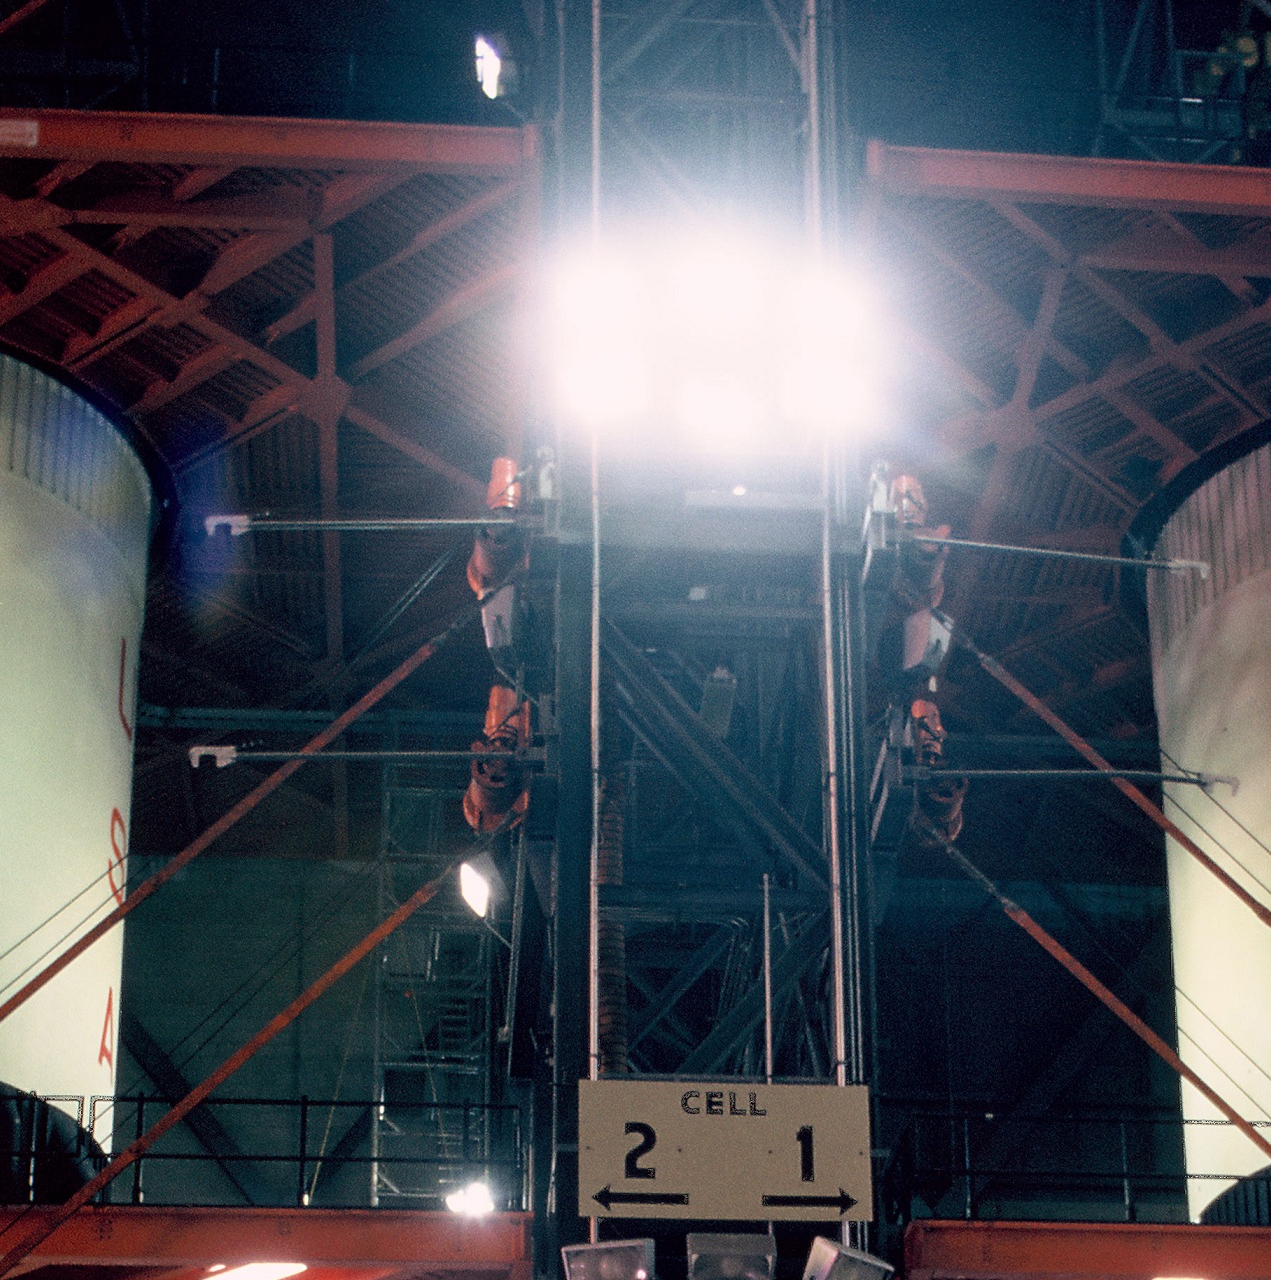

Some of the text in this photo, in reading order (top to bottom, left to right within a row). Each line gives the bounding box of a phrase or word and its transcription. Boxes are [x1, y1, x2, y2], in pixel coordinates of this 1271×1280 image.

[680, 1090, 768, 1116] CELL
[624, 1121, 815, 1182] 2 1
